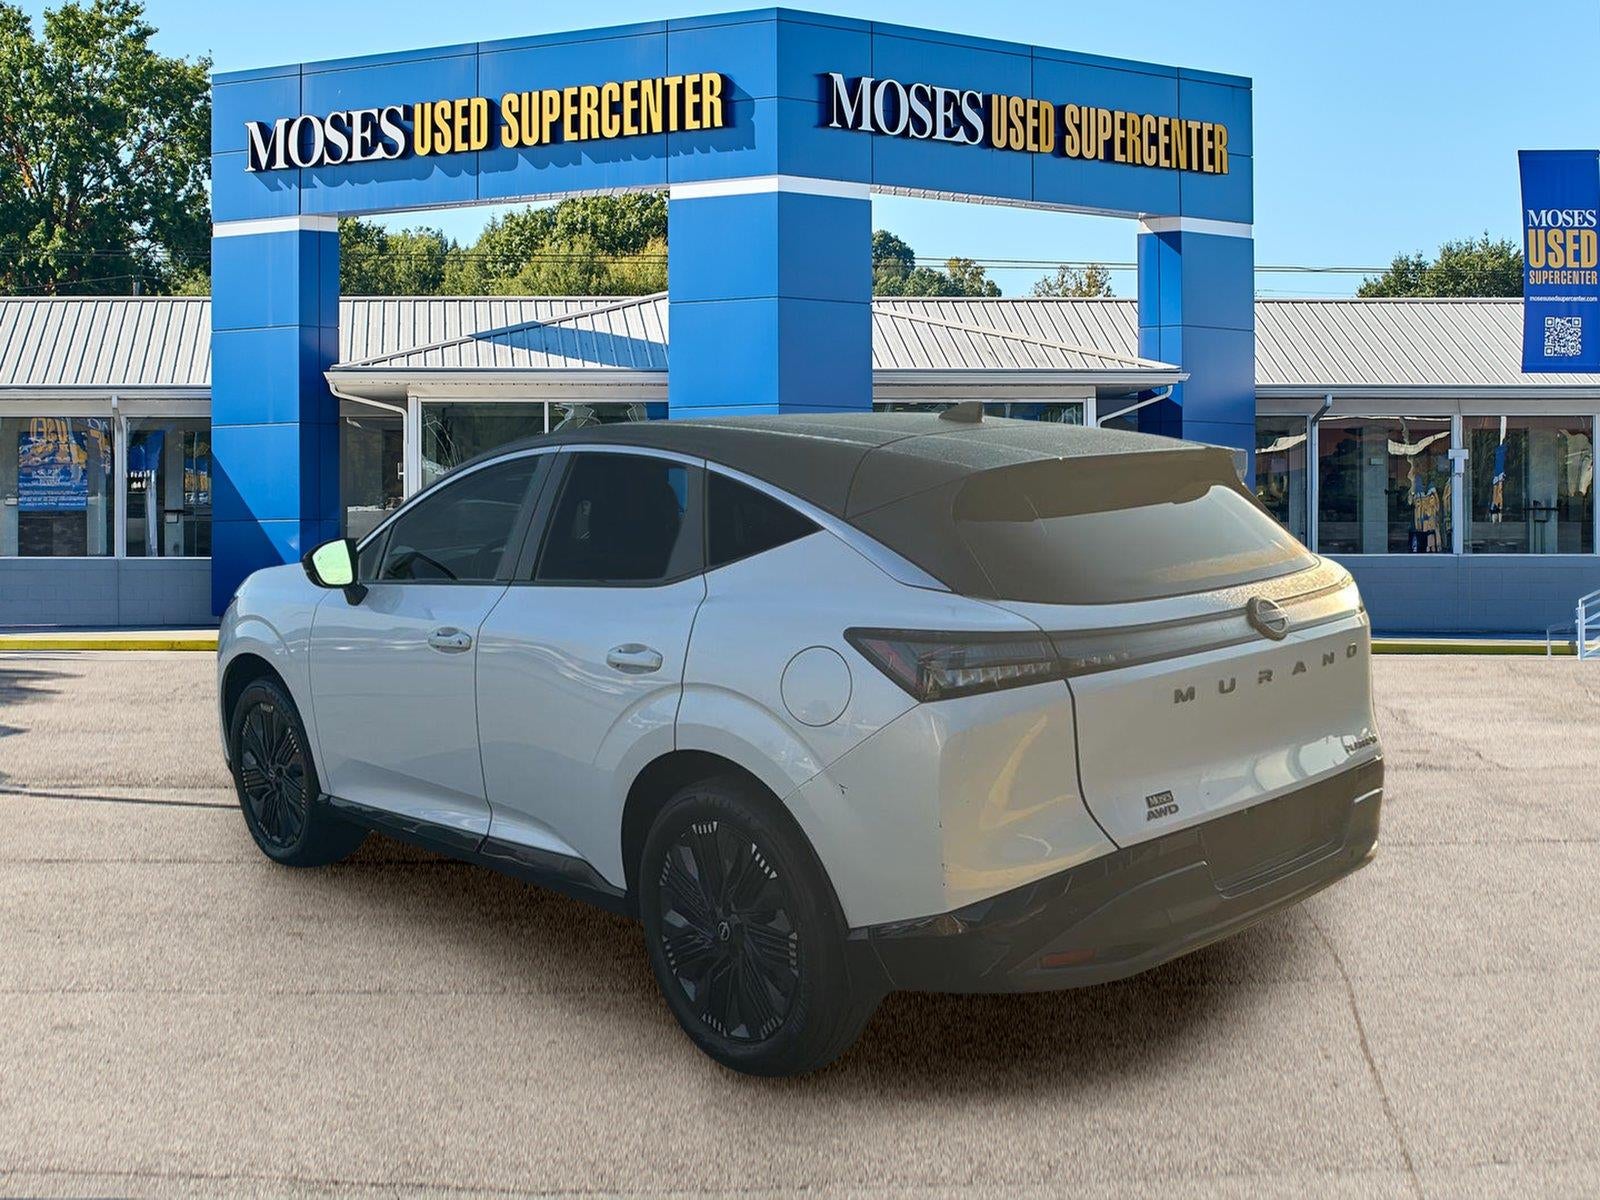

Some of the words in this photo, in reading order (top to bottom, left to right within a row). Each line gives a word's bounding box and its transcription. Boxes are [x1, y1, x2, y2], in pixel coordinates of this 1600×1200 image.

[244, 105, 407, 173] MOSES
[412, 96, 489, 157] USED
[500, 71, 724, 149] SUPERCENTER
[828, 72, 985, 146] MOSES
[991, 93, 1056, 154] USED
[1064, 103, 1230, 175] SUPERCENTER
[1527, 209, 1597, 228] MOSES
[1528, 228, 1598, 269] USED
[1529, 270, 1598, 285] SUPERCENTER
[1173, 642, 1359, 704] MURANO
[1146, 803, 1180, 822] AWD
